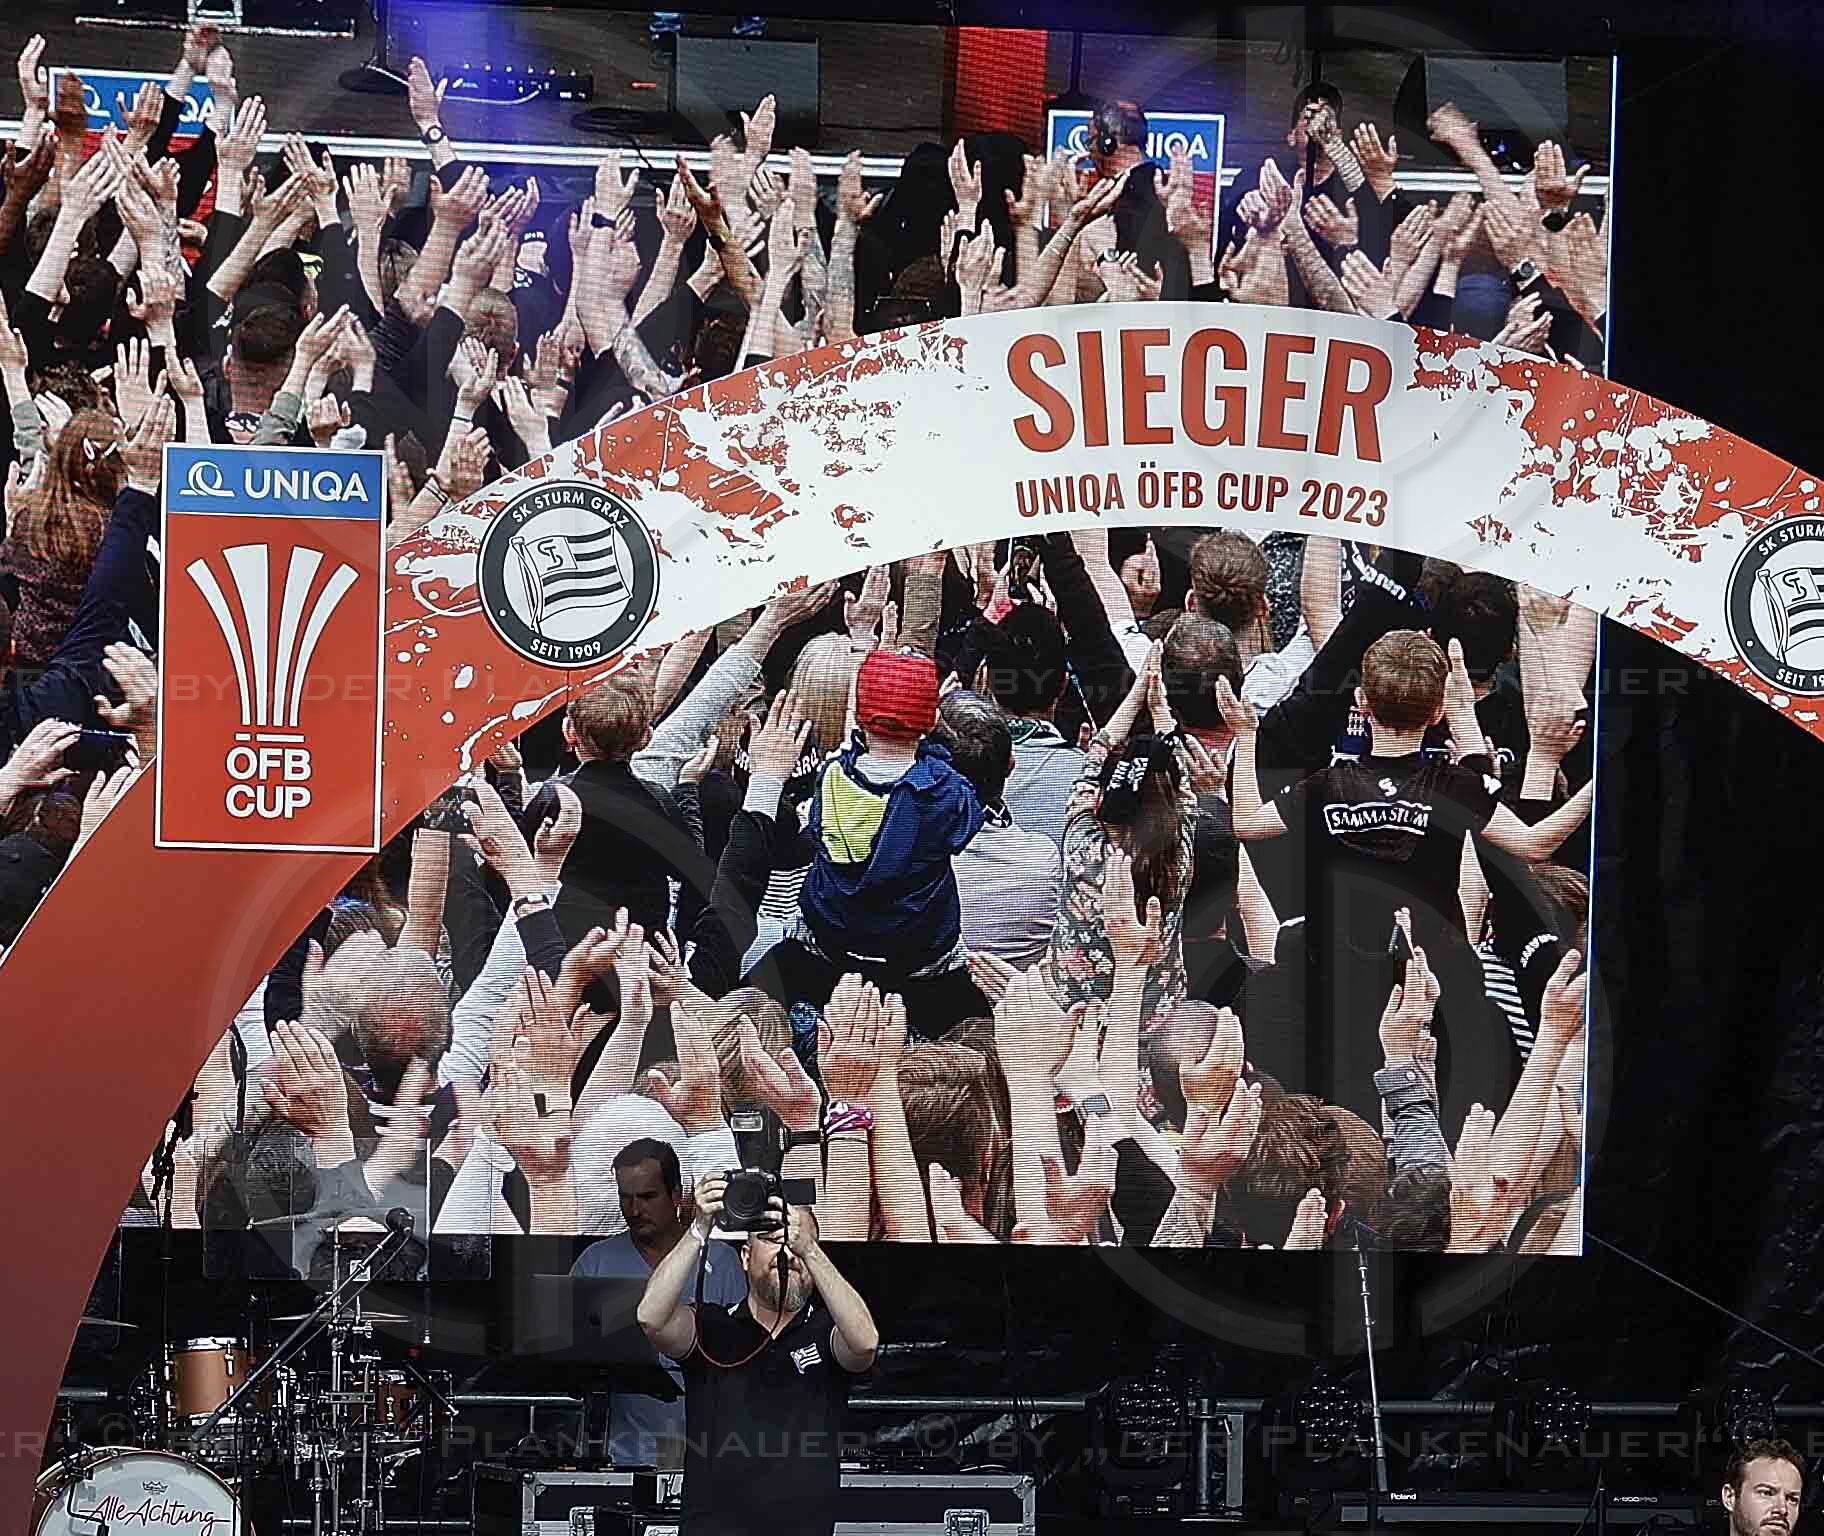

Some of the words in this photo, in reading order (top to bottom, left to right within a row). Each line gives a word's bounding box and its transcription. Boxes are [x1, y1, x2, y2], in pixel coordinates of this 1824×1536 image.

[1007, 328, 1393, 463] SIEGER
[245, 468, 368, 502] UNIQA
[1016, 473, 1125, 518] UNIQA
[1138, 461, 1204, 509] ÖFB
[1218, 472, 1289, 513] CUP
[1300, 479, 1388, 527] 2023
[512, 503, 532, 523] SK
[534, 491, 585, 509] STURM
[591, 497, 631, 529] GRAZ
[1758, 536, 1777, 556] SK
[530, 638, 562, 659] SEIT
[568, 640, 602, 660] 1909
[1775, 668, 1806, 687] SEIT
[225, 785, 312, 819] CUP
[79, 1496, 126, 1524] Alle
[1390, 1492, 1417, 1501] Roland
